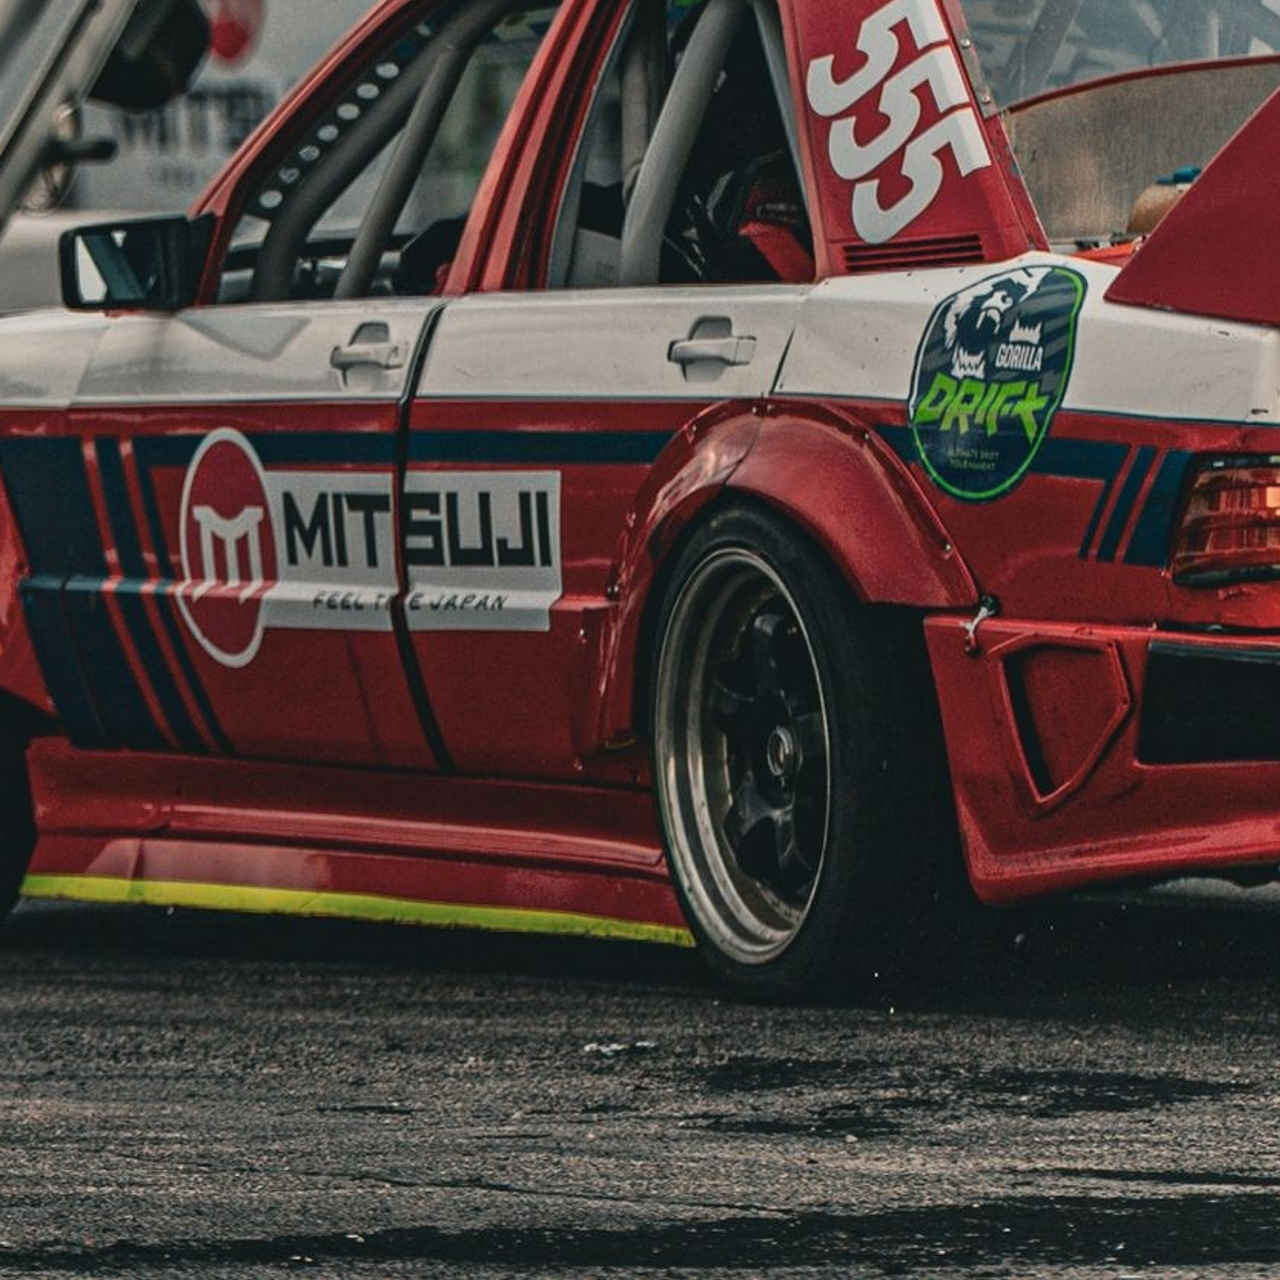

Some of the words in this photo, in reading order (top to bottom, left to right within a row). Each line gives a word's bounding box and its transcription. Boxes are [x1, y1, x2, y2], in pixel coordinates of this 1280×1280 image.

[995, 343, 1043, 371] GORILLA
[914, 373, 1048, 444] DRIFT
[282, 491, 552, 567] MITSUJI
[313, 592, 366, 610] FEEL
[429, 593, 508, 611] JAPAN
